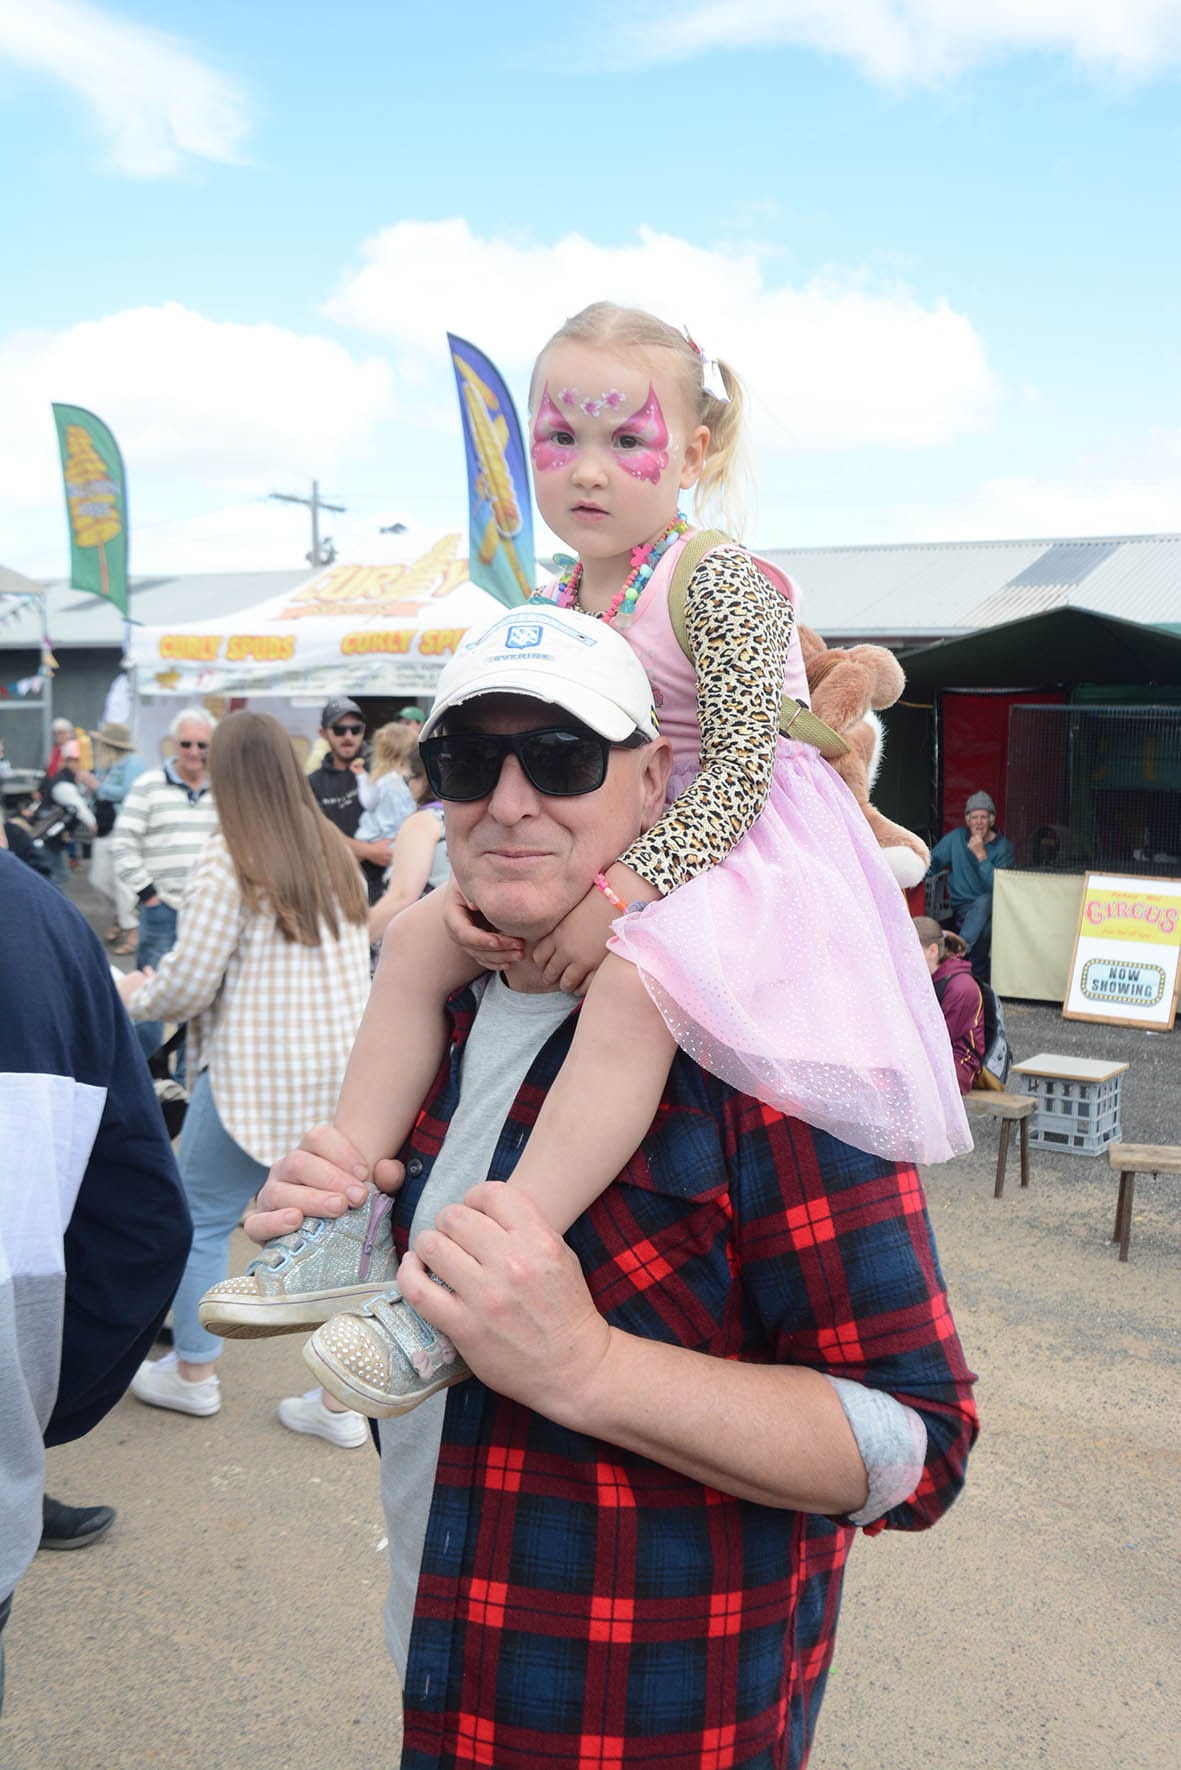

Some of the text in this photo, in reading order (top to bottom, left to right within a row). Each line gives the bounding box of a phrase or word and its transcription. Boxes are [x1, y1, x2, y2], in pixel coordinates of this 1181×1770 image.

[159, 635, 295, 662] CURLY SPUDS
[341, 629, 417, 656] CURLY
[1086, 900, 1179, 933] CIRCUS
[1108, 967, 1141, 982] NOW
[1091, 980, 1153, 998] SHOWING
